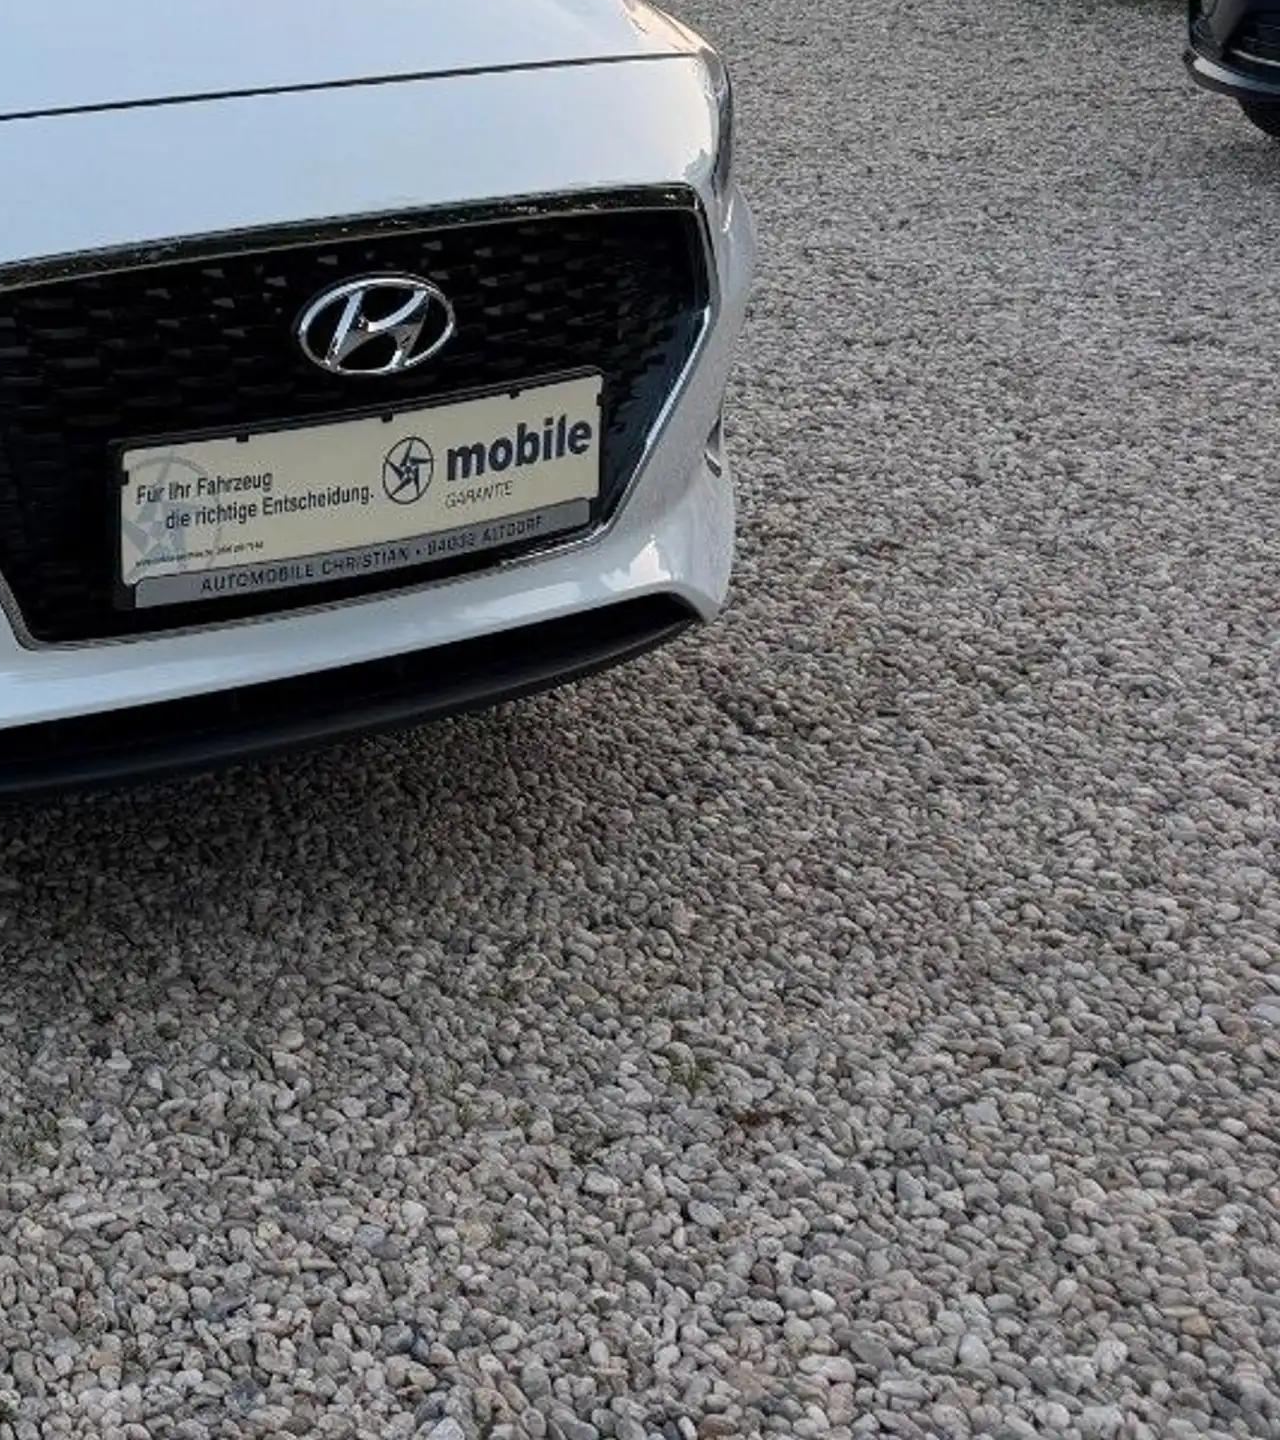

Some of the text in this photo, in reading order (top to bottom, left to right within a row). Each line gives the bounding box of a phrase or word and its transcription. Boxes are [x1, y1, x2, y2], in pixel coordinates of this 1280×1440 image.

[447, 414, 593, 482] mobile
[165, 484, 376, 530] die richtige Entscheidung.
[168, 481, 192, 501] Ihr
[196, 472, 274, 497] Fahrzeug
[445, 479, 514, 510] GARANTIE
[201, 562, 314, 594] AUTOMOBILE
[321, 546, 410, 577] CHRISTIAN
